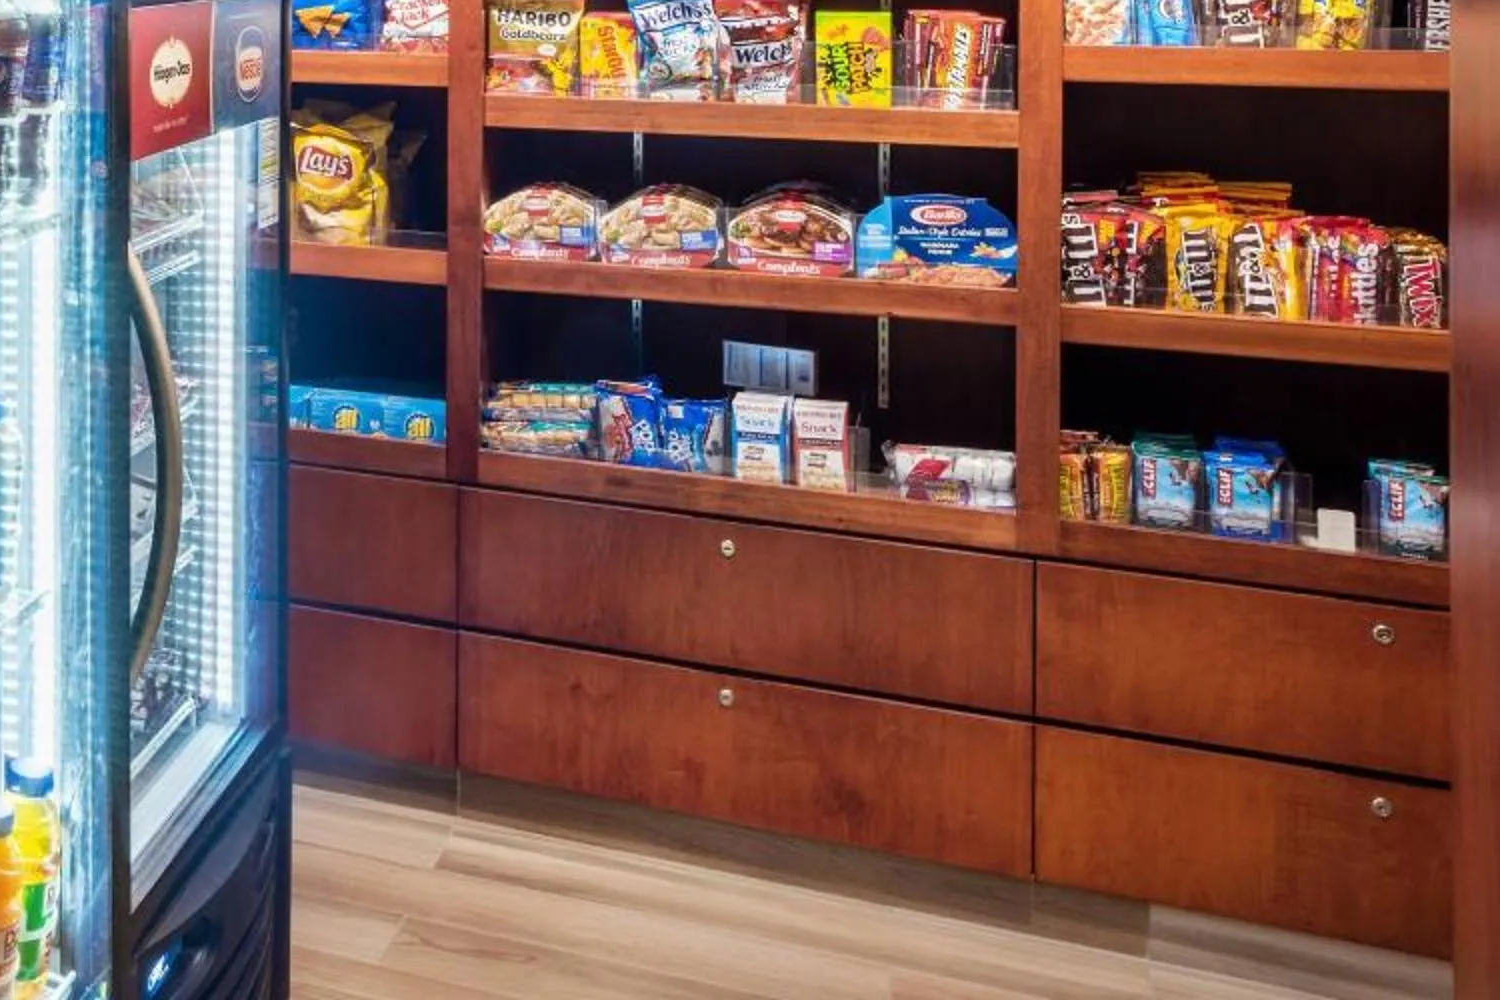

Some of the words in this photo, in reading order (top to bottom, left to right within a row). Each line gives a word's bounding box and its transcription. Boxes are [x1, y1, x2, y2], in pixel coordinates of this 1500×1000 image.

[497, 7, 571, 27] HARIBO
[834, 42, 849, 92] SOUR
[849, 42, 866, 94] PATCH
[300, 145, 350, 177] Lay's
